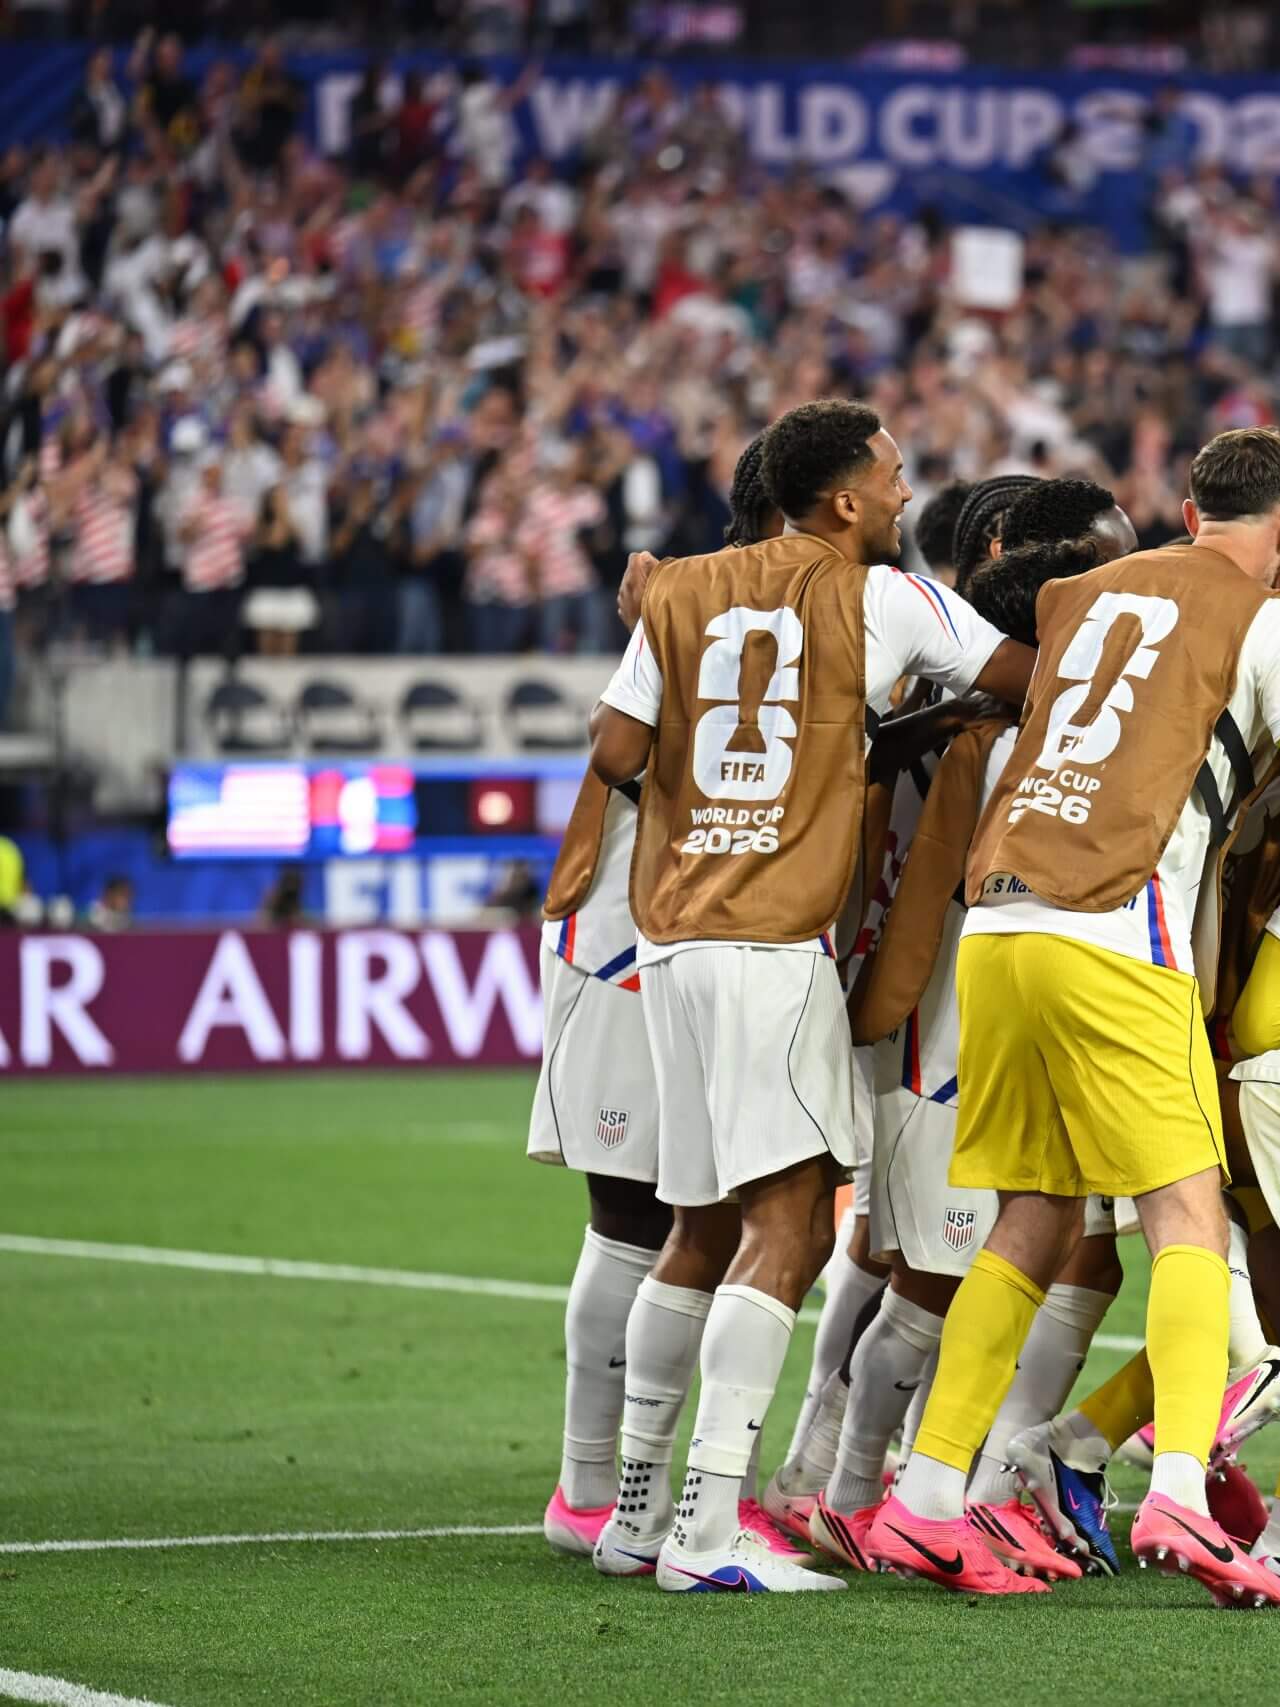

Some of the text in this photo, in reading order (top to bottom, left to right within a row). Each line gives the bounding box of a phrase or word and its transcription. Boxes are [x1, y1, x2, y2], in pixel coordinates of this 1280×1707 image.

[528, 78, 868, 160] WLD
[880, 83, 1062, 169] CUP
[720, 761, 765, 782] FIFA
[1059, 769, 1101, 794] CUP
[690, 806, 751, 826] WORLD
[1008, 785, 1092, 825] 226
[680, 825, 780, 855] 2026
[600, 1109, 627, 1127] USA
[947, 1211, 974, 1228] USA
